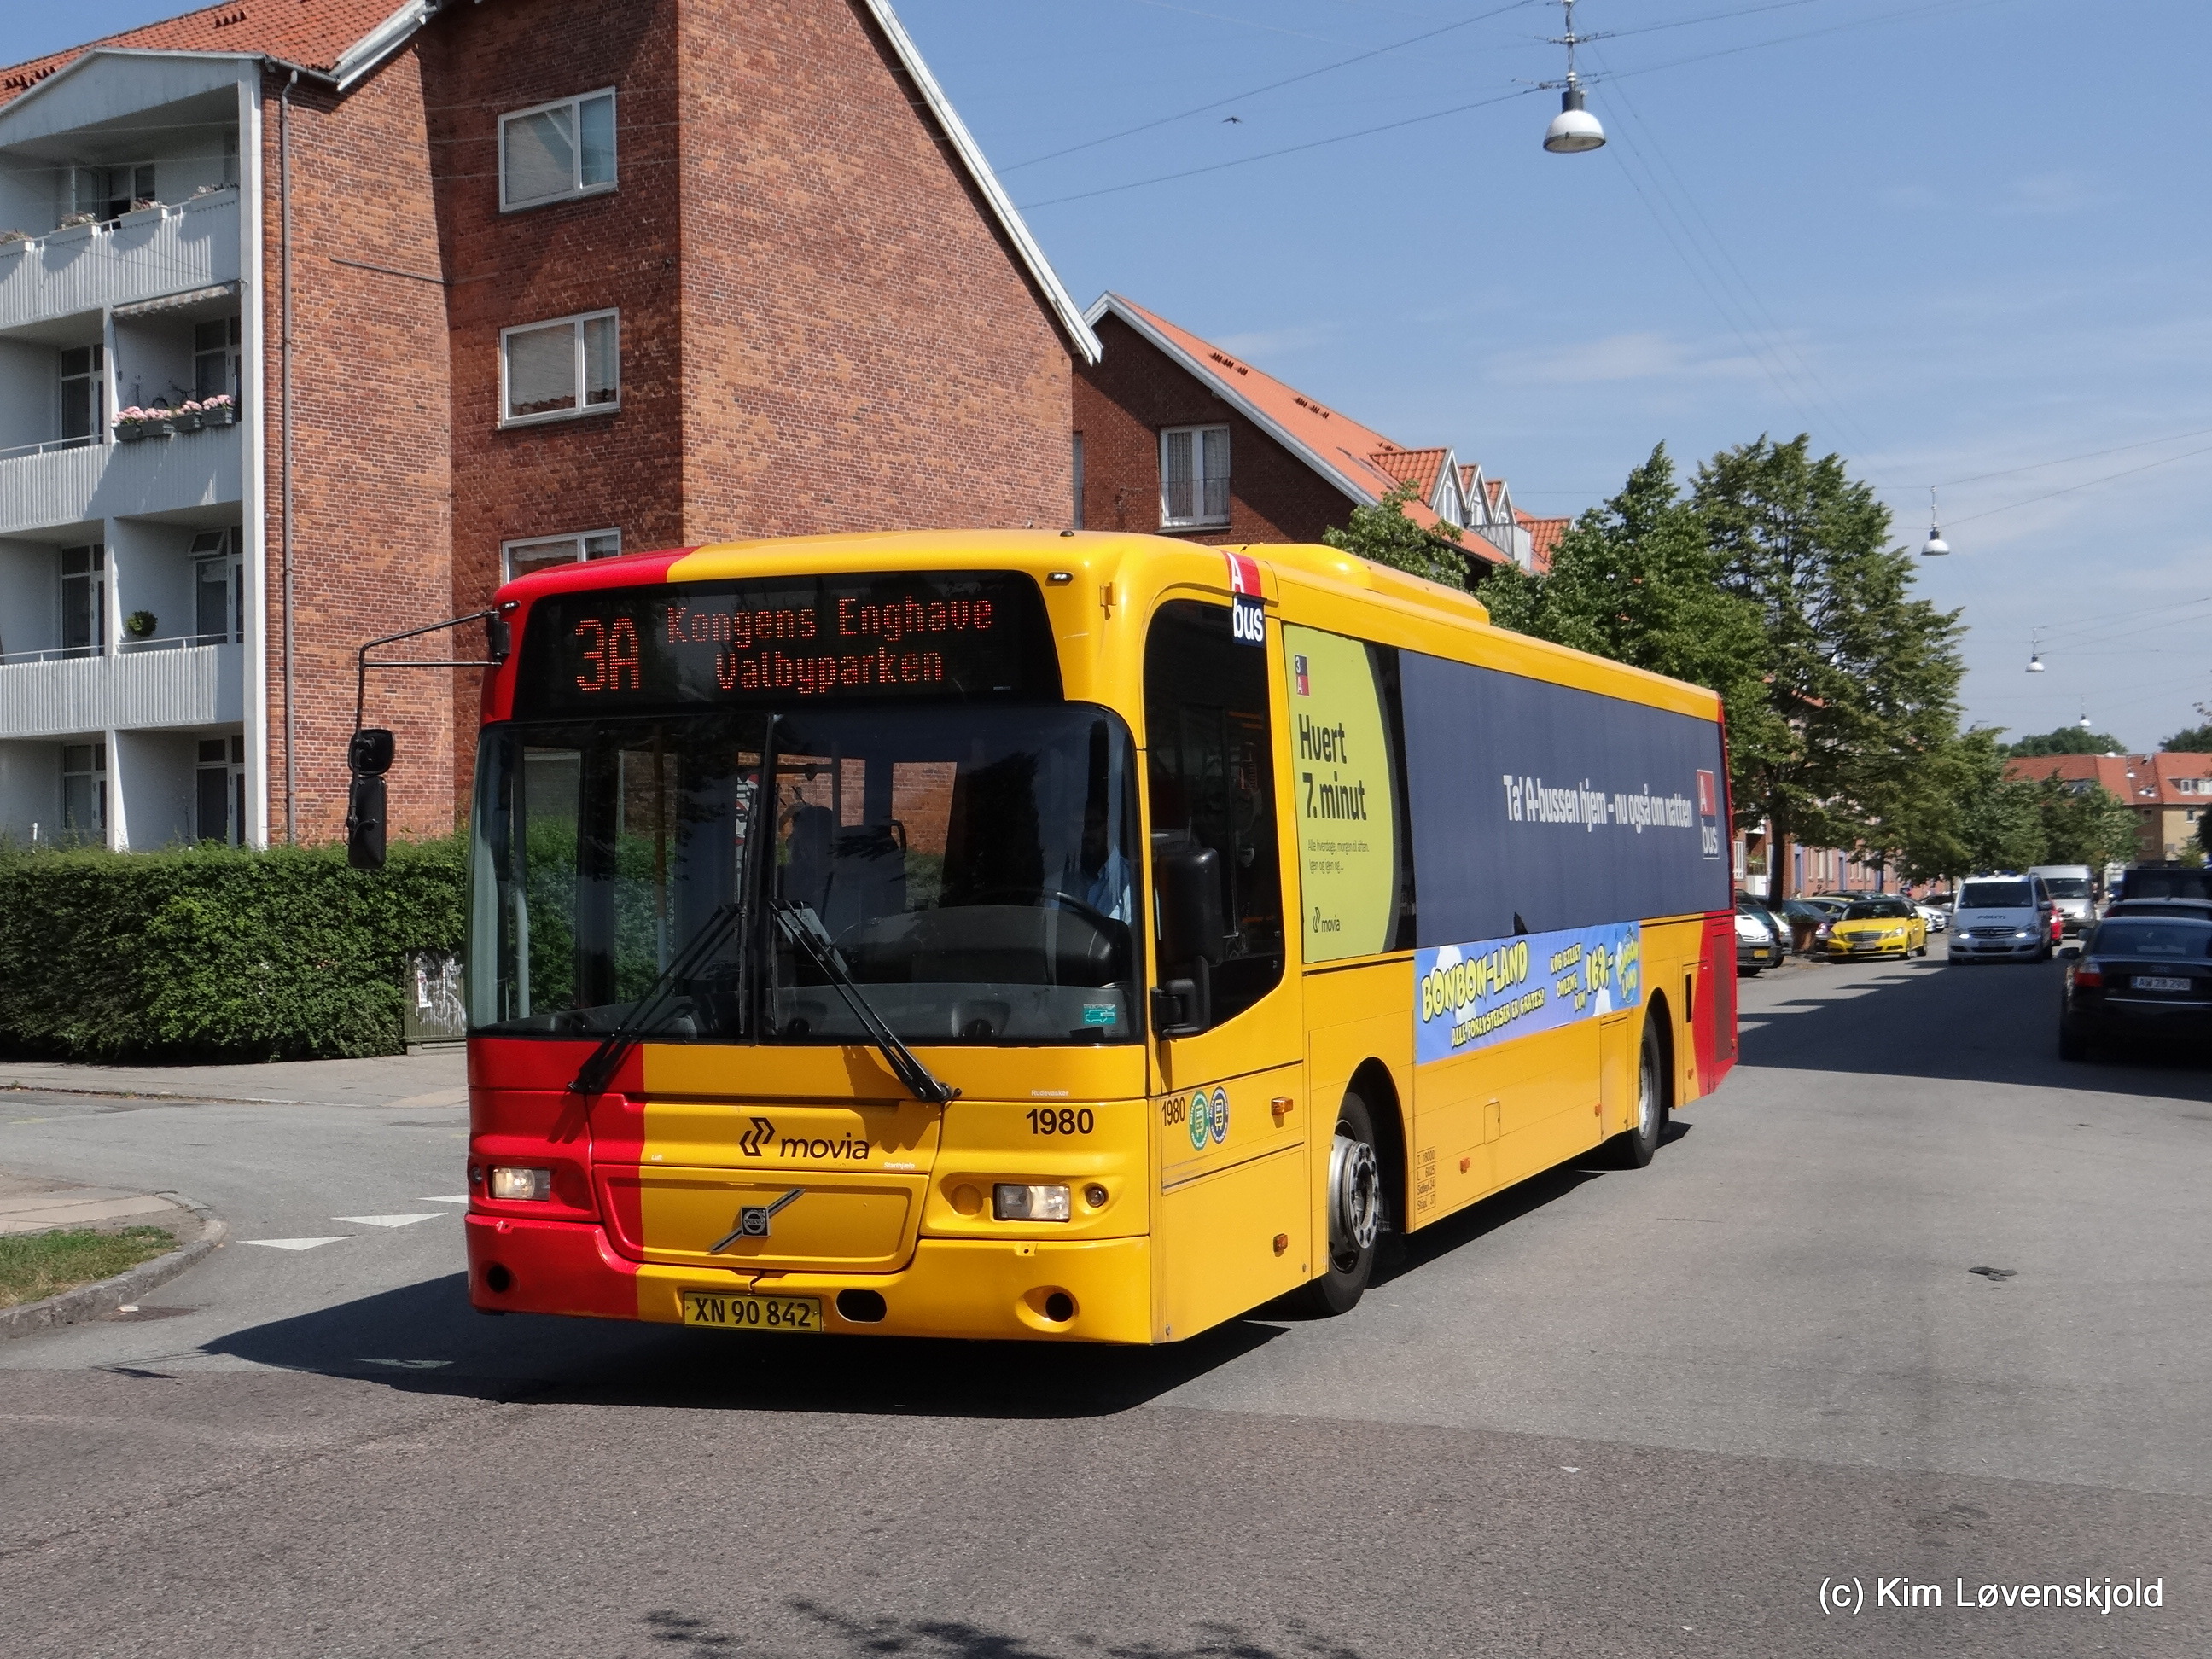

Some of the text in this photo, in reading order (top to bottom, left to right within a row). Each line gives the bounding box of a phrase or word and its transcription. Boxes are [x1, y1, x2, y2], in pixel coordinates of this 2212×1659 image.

[1226, 552, 1245, 594] A
[667, 597, 994, 648] Kongens Enghave
[1233, 596, 1263, 642] bus
[575, 617, 639, 691] 3A
[716, 646, 943, 694] Valbyparken
[1298, 713, 1348, 764] Hvert
[1302, 771, 1367, 821] 7. minut
[1503, 775, 1522, 822] Ta'
[1525, 777, 1579, 823] A-bussen
[1579, 777, 1607, 833] hjem
[1615, 793, 1627, 824] nu
[1629, 783, 1650, 834] også
[1651, 796, 1665, 826] om
[1665, 793, 1693, 828] natten
[1699, 775, 1708, 812] A
[1702, 817, 1718, 854] bus
[1322, 914, 1341, 933] movia
[1420, 940, 1528, 1024] BONBON-LAND
[1452, 1022, 1466, 1050] ALLE
[1026, 1108, 1095, 1136] 1980
[1161, 1096, 1185, 1126] 1980
[780, 1132, 870, 1161] movia
[694, 1297, 812, 1328] XN 90 842
